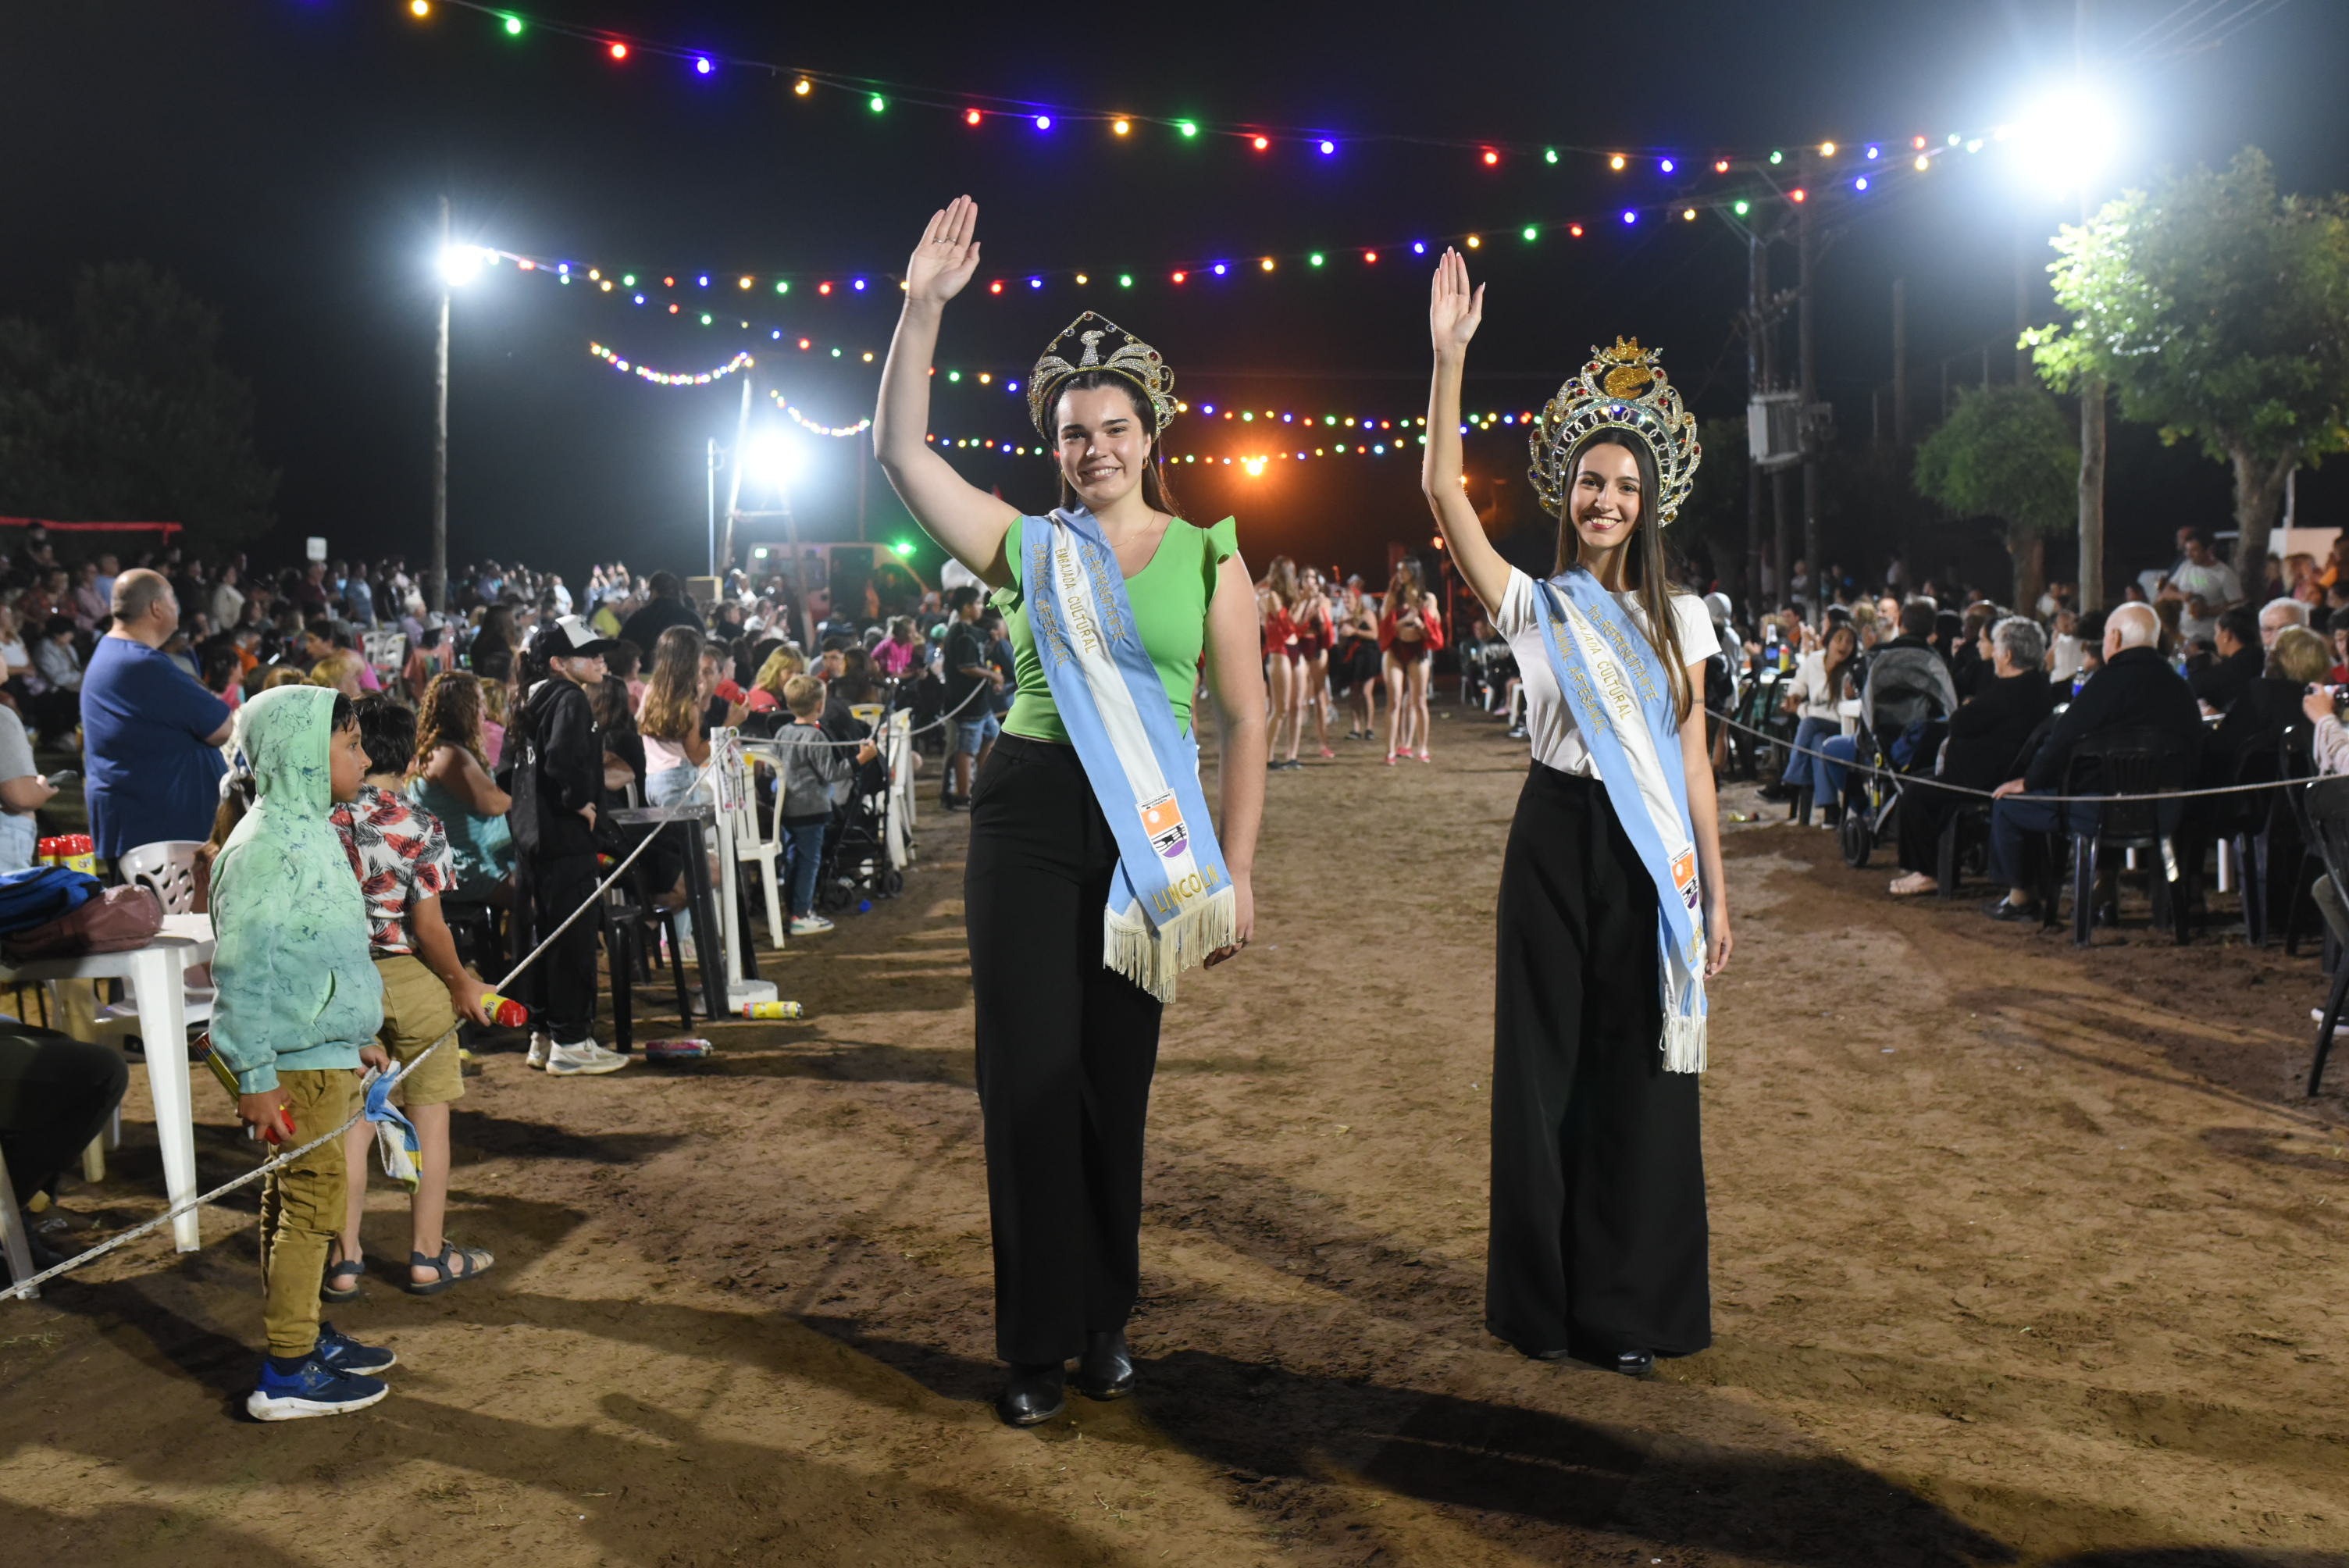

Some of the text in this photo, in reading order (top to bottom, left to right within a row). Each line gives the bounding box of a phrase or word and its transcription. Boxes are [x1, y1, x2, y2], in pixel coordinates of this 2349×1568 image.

[1032, 543, 1070, 667] CARNAVAL ARTESANAL
[1055, 548, 1098, 654] EMBAJADA CULTURAL
[1089, 559, 1125, 640] REPRESENTANTE
[1567, 666, 1609, 736] ARTESANAL
[1597, 661, 1632, 721] CULTURAL
[1601, 620, 1658, 703] REPRESENTANTE
[1152, 862, 1220, 913] LINCOLN
